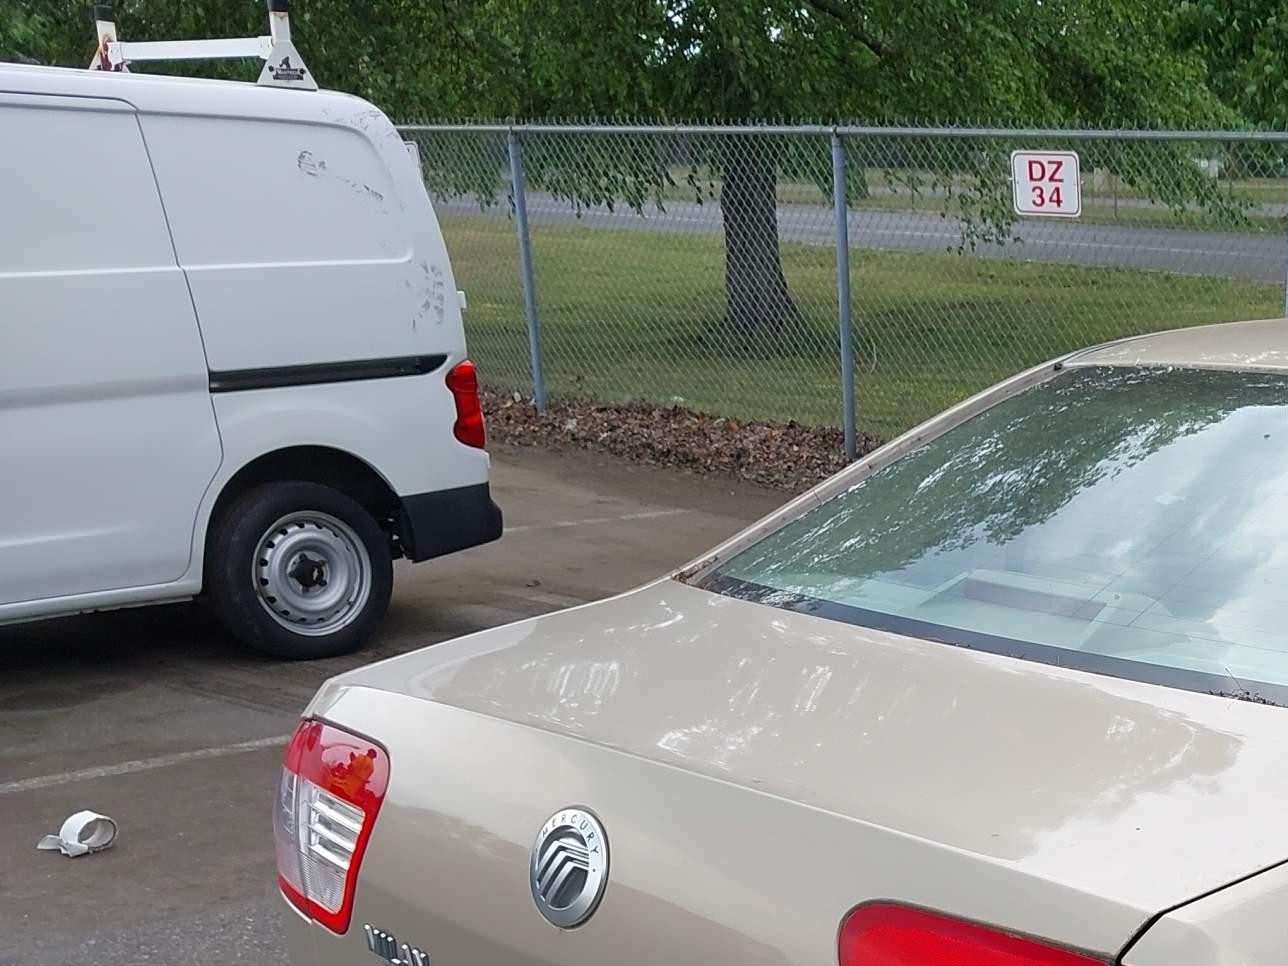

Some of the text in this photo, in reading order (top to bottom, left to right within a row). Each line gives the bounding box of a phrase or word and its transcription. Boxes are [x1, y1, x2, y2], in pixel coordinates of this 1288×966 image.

[1028, 160, 1065, 183] DZ
[1031, 185, 1064, 208] 34
[541, 813, 600, 854] MERCURY
